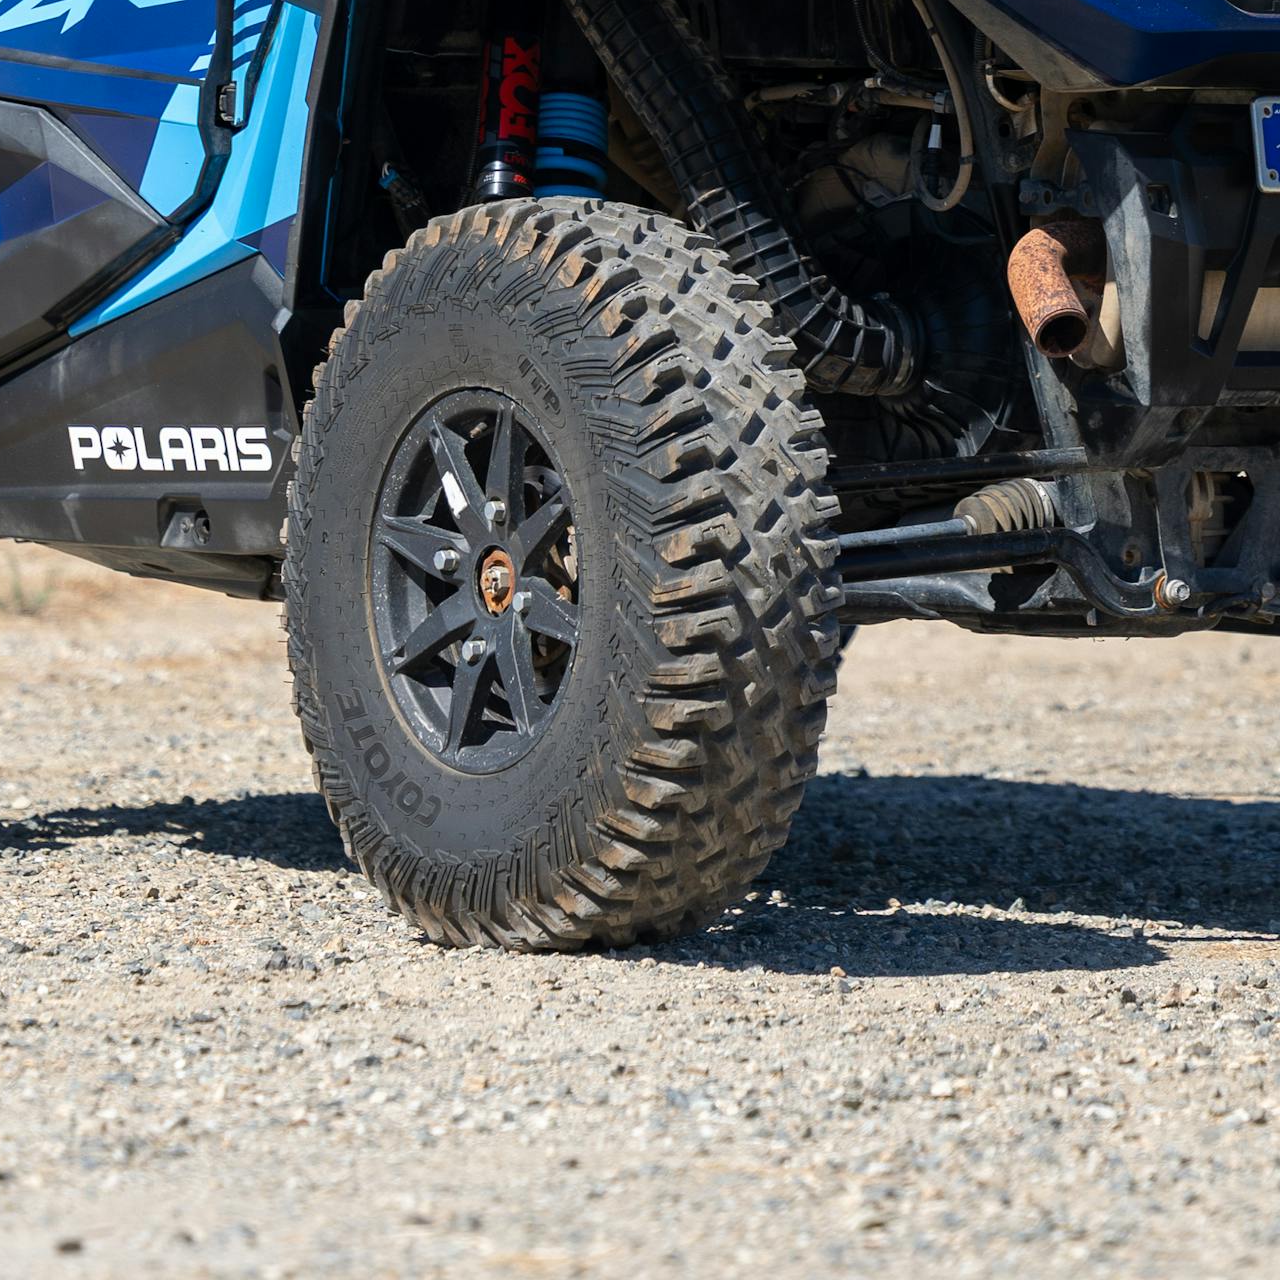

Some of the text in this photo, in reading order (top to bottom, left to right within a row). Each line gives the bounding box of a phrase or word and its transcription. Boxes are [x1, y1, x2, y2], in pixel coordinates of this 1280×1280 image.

[498, 36, 542, 143] FOX
[519, 357, 562, 416] ITP
[67, 426, 273, 471] POLARIS
[334, 687, 443, 828] COYOTE
